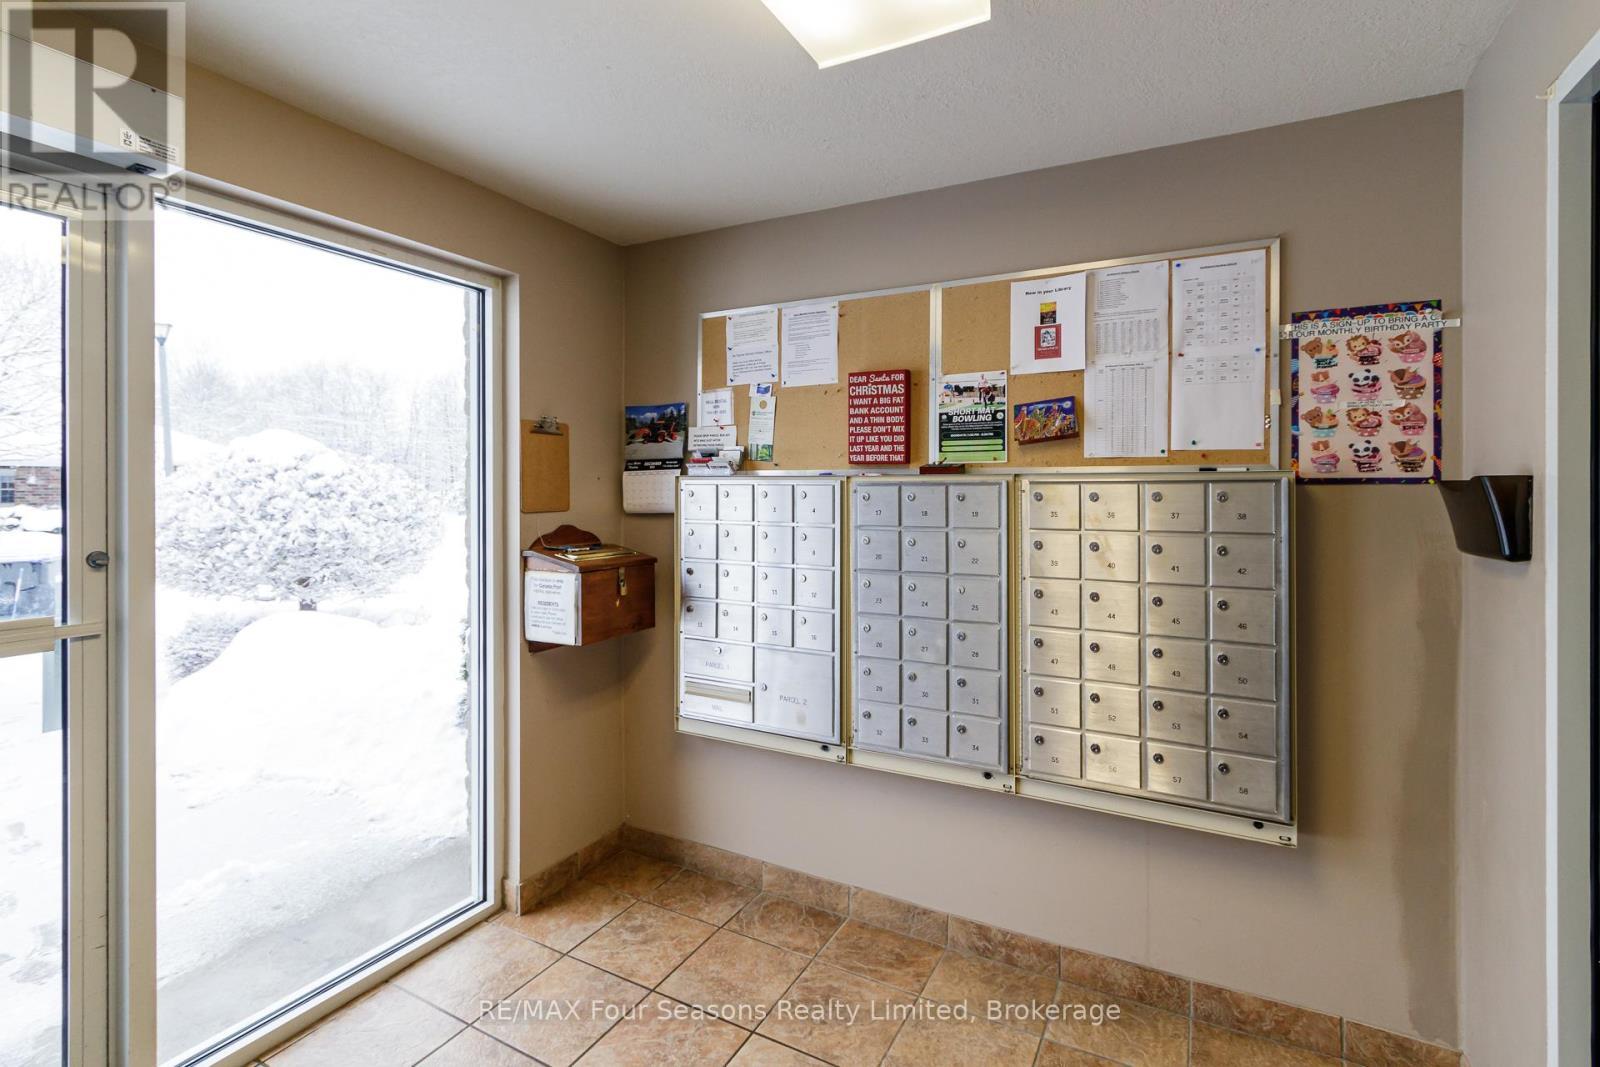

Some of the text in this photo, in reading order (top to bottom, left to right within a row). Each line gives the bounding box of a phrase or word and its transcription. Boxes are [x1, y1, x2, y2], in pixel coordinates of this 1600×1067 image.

[1322, 320, 1330, 328] A
[1373, 317, 1385, 325] TO
[1388, 314, 1418, 324] BRING
[1295, 329, 1316, 338] OUR
[1318, 327, 1361, 336] MONTHLY
[1364, 323, 1411, 333] BIRTHDAY
[1414, 320, 1448, 331] PARTY
[869, 374, 890, 383] Santa
[891, 373, 905, 381] FOR
[870, 406, 904, 414] ACCOUNT
[948, 407, 976, 416] SHORT
[952, 413, 992, 423] BOWLING
[1106, 511, 1116, 519] 36
[1170, 511, 1180, 520] 37
[1236, 512, 1248, 521] 38
[1170, 565, 1180, 573] 41
[1237, 567, 1248, 575] 42
[1050, 608, 1059, 616] 43
[1107, 612, 1116, 620] 44
[1171, 617, 1181, 625] 45
[1237, 622, 1248, 630] 46
[1107, 663, 1116, 671] 48
[1171, 670, 1181, 678] 49
[1237, 676, 1249, 685] 50
[779, 695, 801, 705] PARCEL
[1050, 707, 1059, 715] 51
[1107, 714, 1117, 722] 52
[1171, 722, 1182, 731] 53
[1238, 731, 1249, 740] 54
[1172, 776, 1182, 784] 57
[1238, 786, 1249, 796] 58
